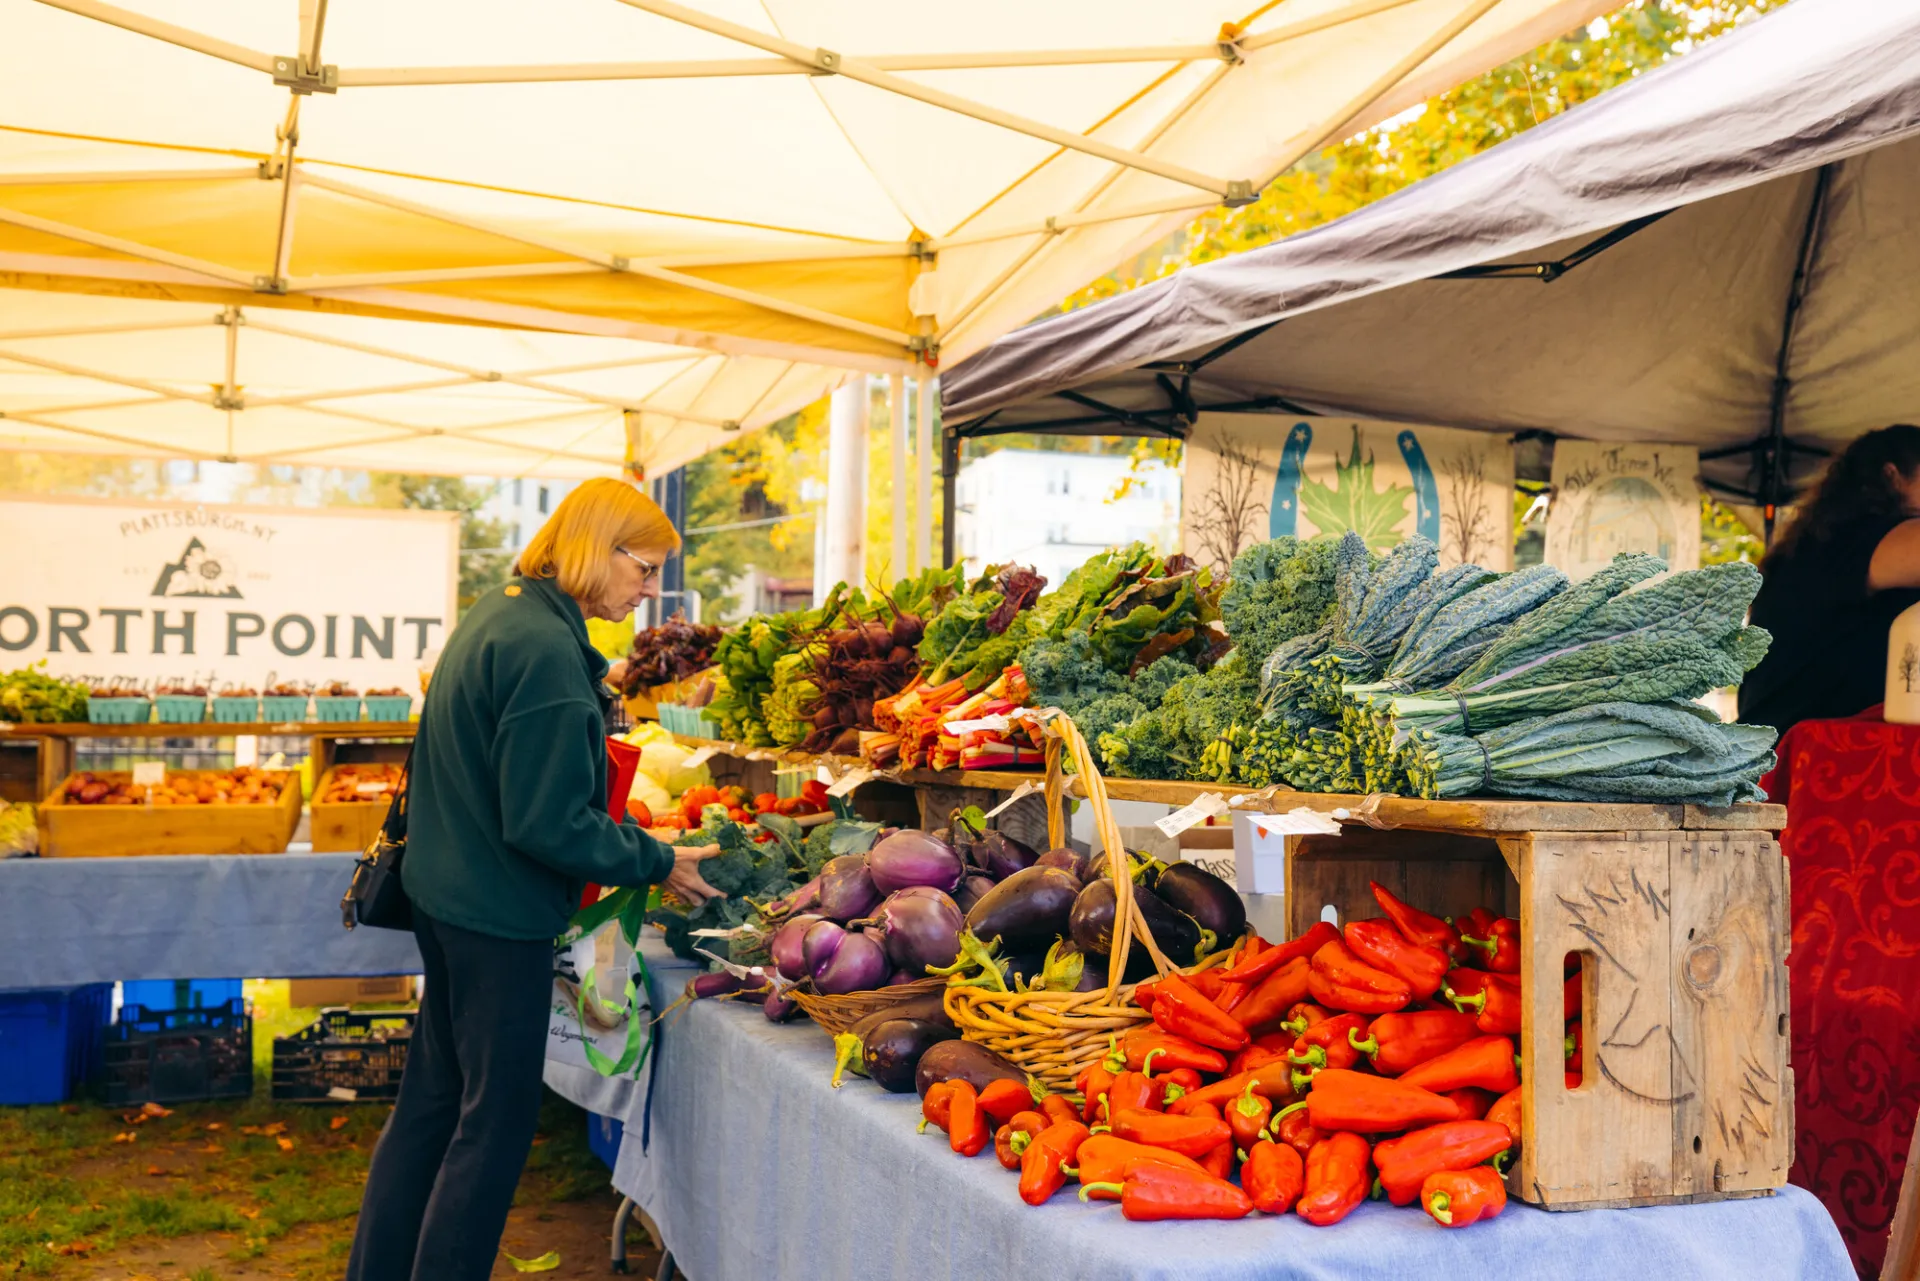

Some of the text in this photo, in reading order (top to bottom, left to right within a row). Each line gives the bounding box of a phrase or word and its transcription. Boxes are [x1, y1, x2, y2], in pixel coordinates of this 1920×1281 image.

[252, 525, 278, 543] NY
[0, 606, 442, 660] ORTH POINT
